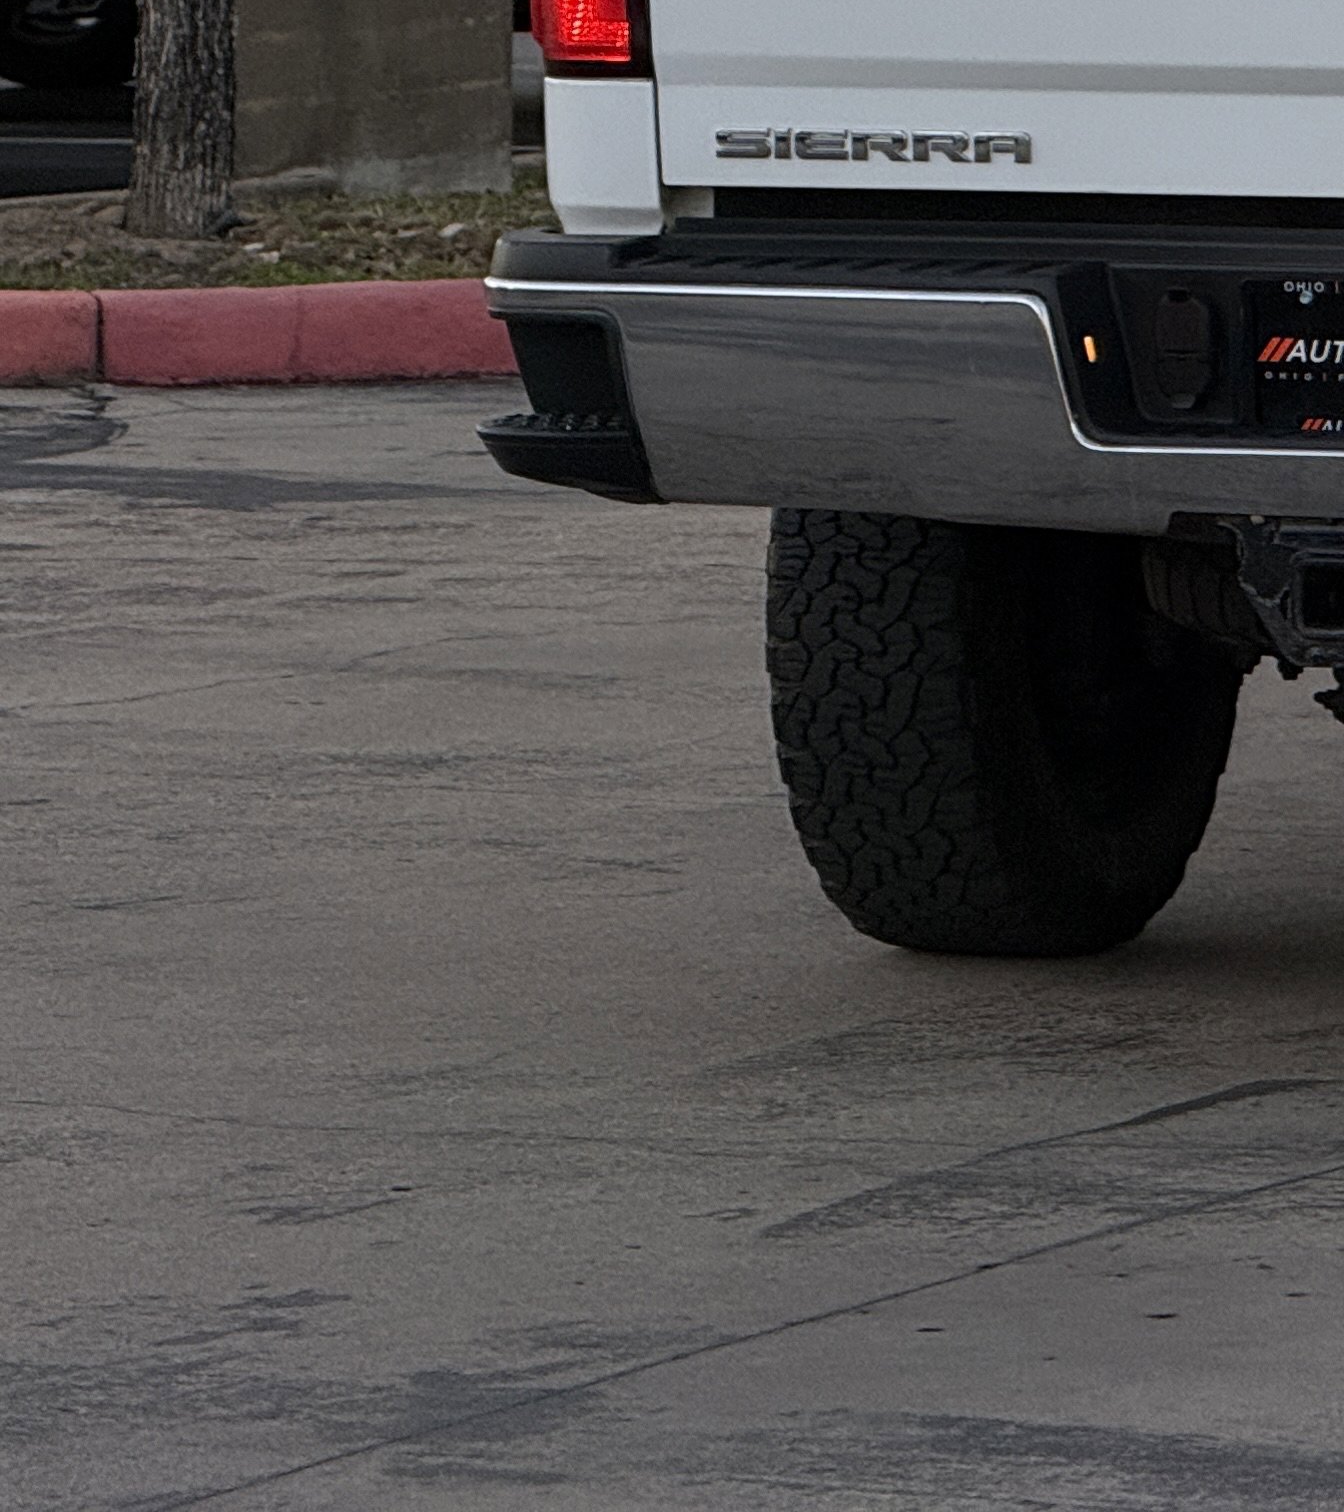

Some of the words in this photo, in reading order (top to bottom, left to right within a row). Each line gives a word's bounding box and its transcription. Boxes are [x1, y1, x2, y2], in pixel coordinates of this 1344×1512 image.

[715, 127, 1032, 164] SIERRA
[1283, 281, 1325, 293] OHIO
[1264, 370, 1313, 381] OHIO
